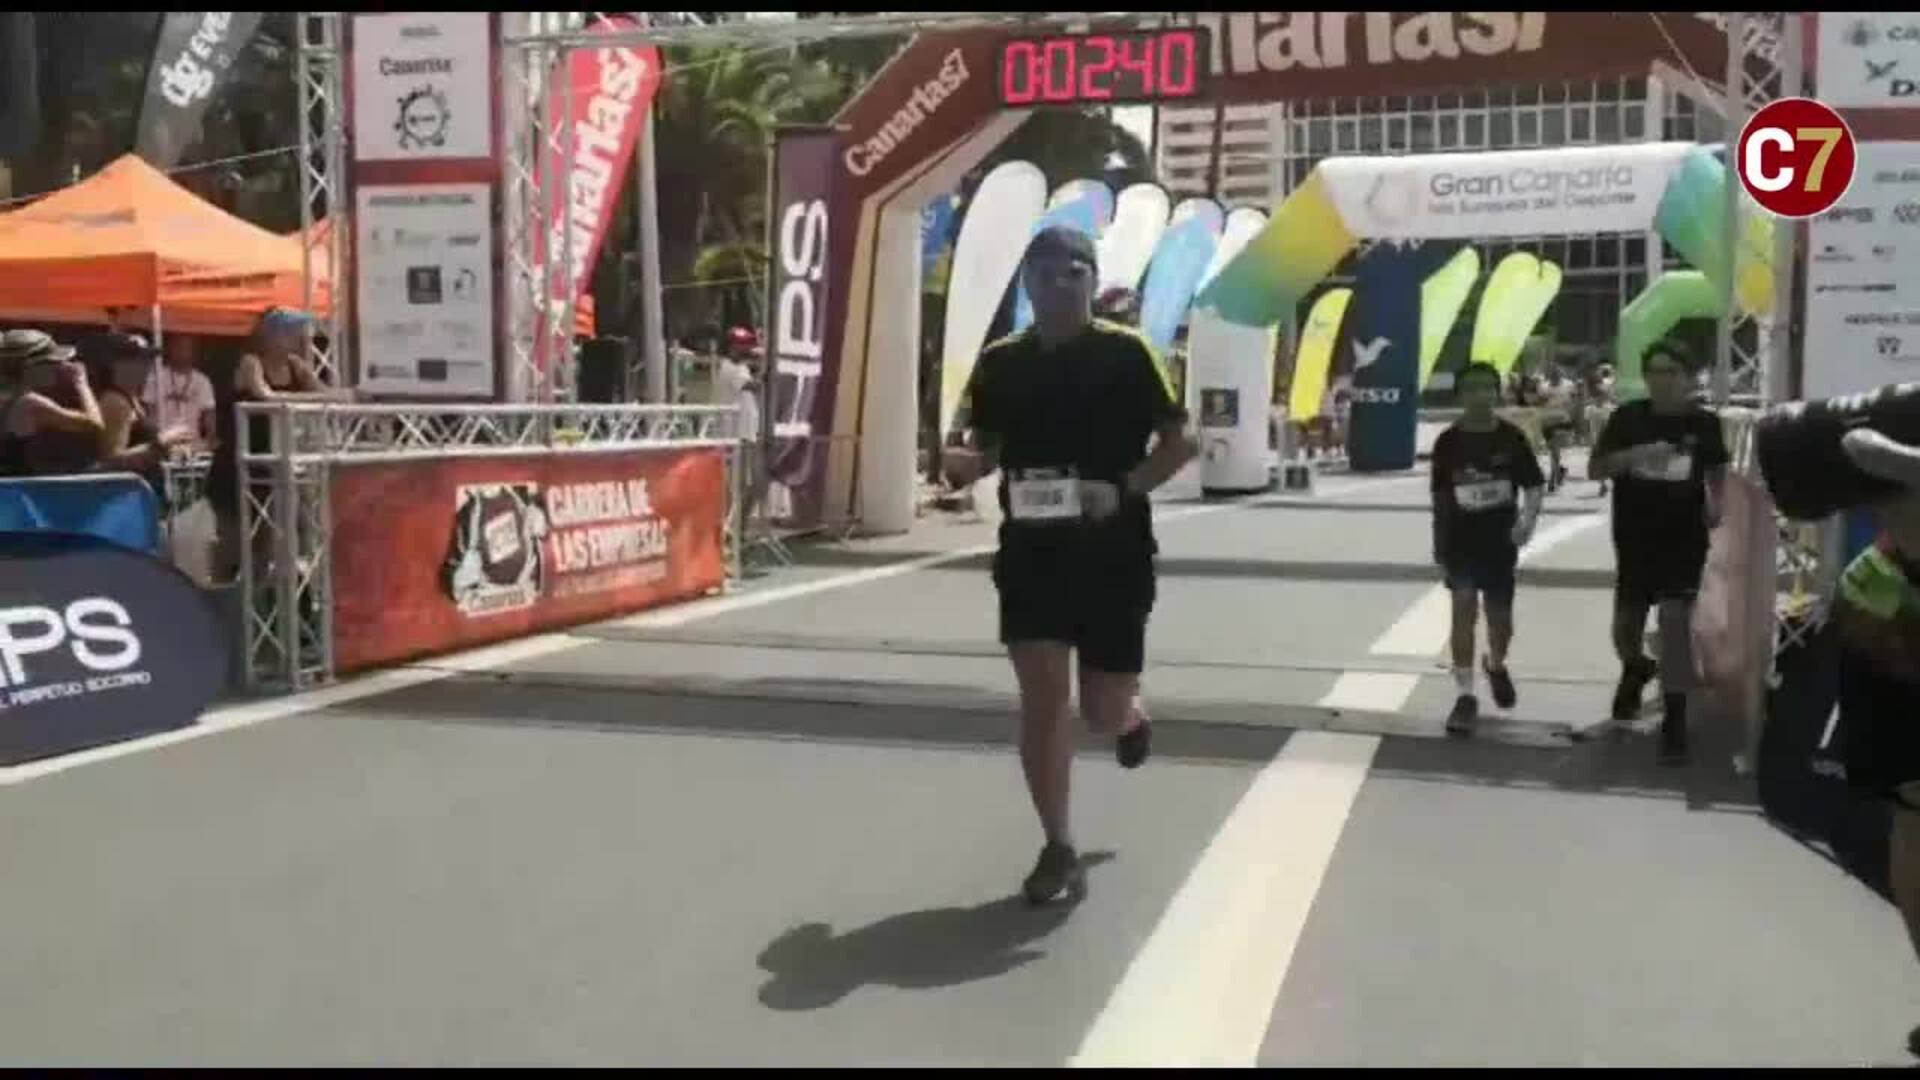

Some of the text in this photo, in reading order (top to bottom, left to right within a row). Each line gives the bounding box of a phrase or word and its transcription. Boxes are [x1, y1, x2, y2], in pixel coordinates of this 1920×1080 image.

[845, 48, 970, 175] Canarias7
[1430, 172, 1502, 197] Gran
[772, 199, 829, 438] HPS
[552, 527, 588, 572] LAS
[0, 597, 141, 690] PS
